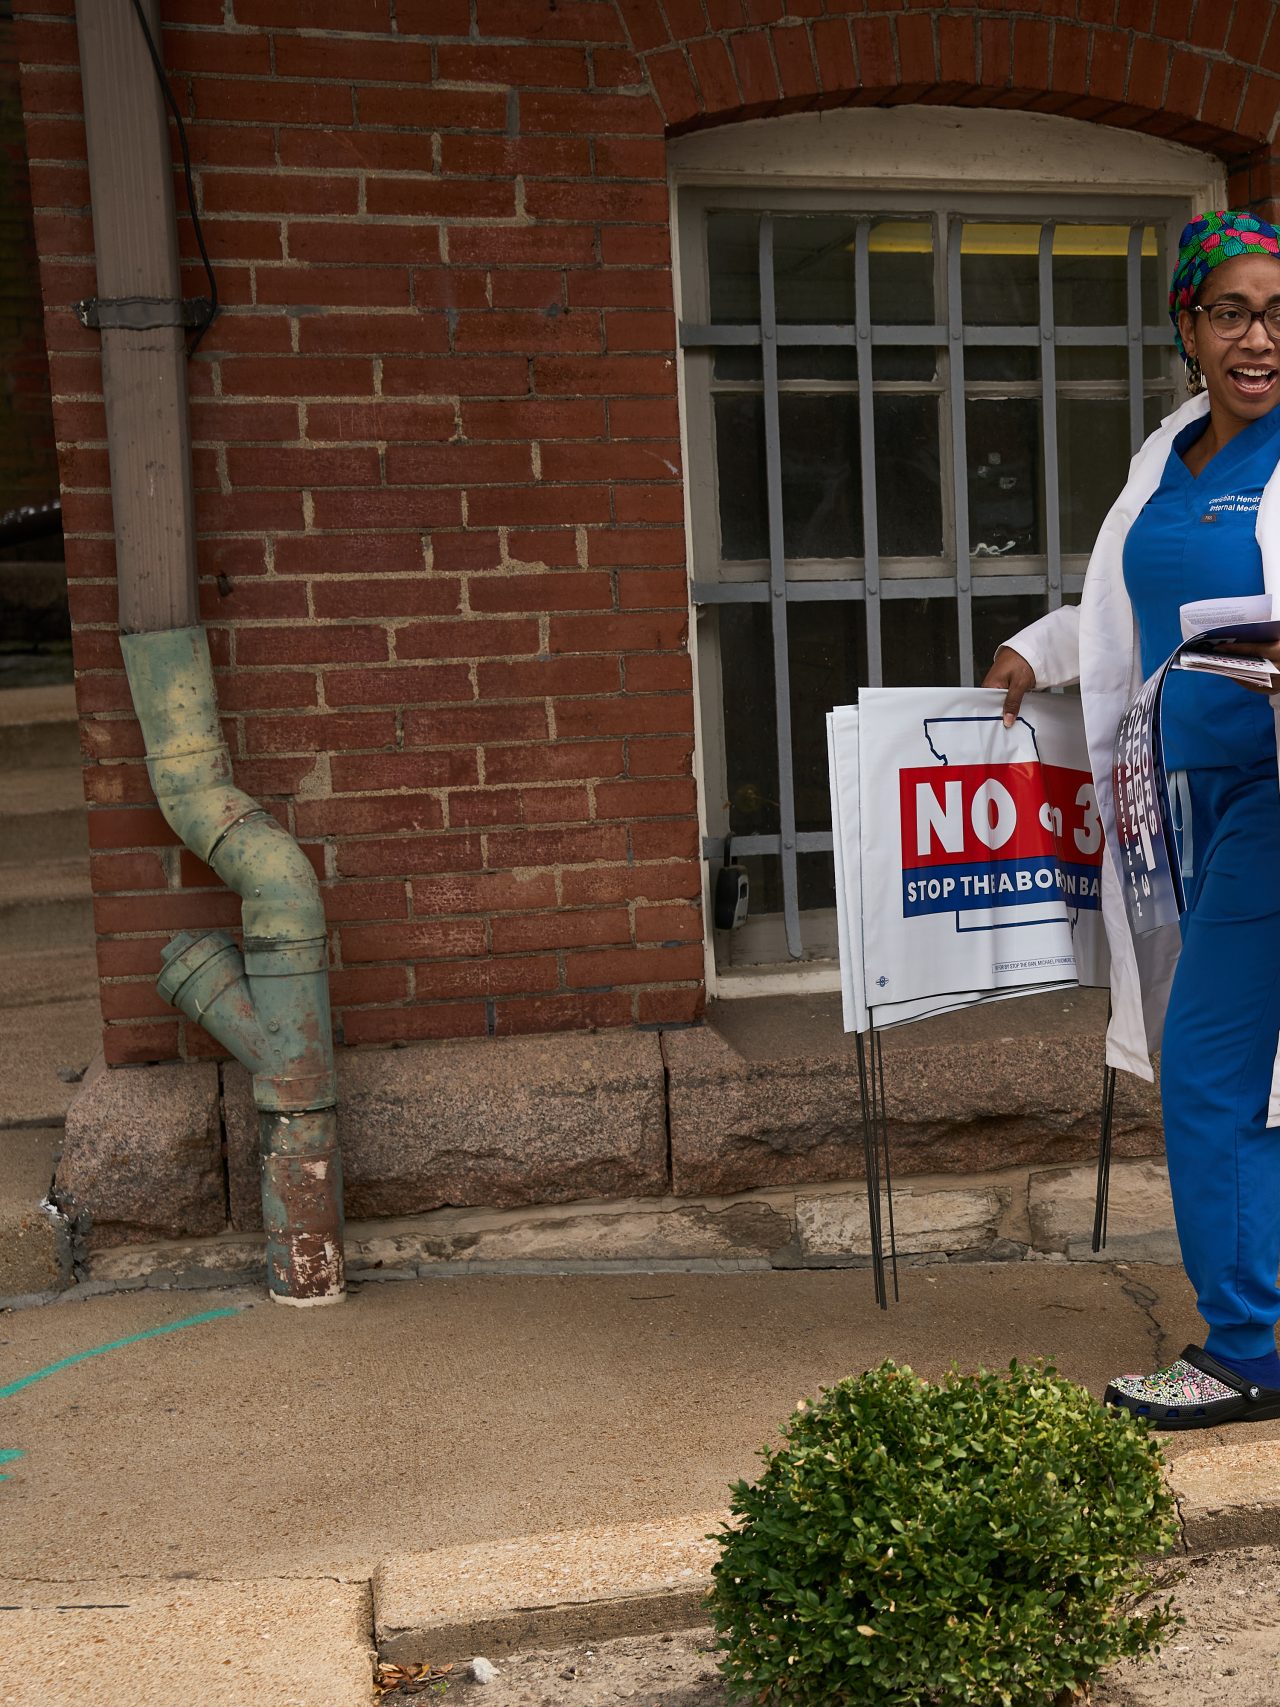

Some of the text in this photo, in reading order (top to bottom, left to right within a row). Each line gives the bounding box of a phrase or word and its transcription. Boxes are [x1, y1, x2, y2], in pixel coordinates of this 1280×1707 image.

[915, 778, 1017, 856] NO
[1073, 783, 1102, 855] 3
[907, 868, 1101, 904] STOP THE ABORON BA
[1131, 871, 1143, 917] BAN
[1141, 873, 1151, 898] 3
